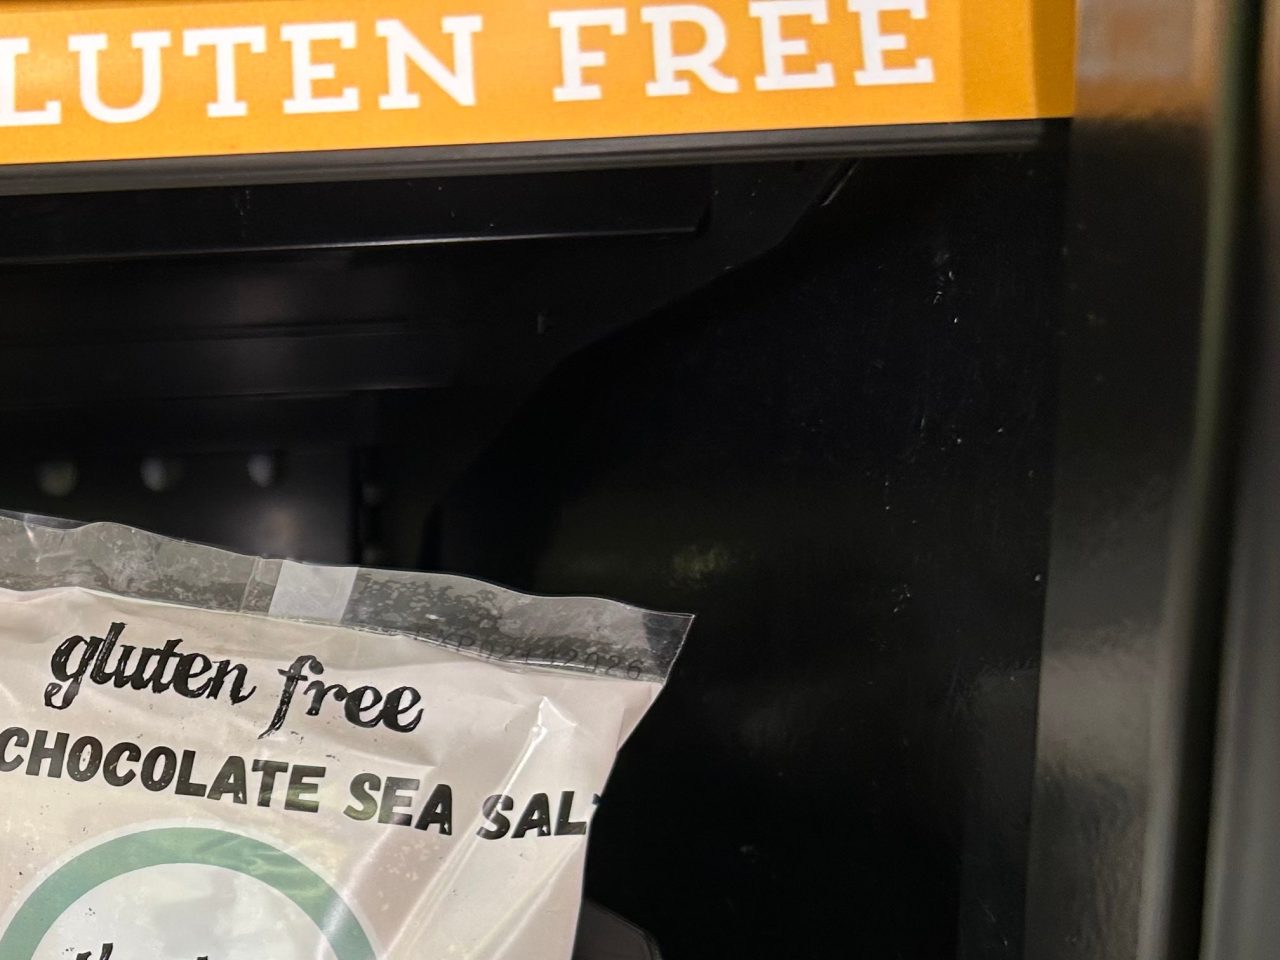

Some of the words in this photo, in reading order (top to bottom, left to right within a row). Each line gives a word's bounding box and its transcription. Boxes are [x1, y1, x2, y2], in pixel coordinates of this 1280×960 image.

[551, 0, 935, 103] FREE
[44, 622, 257, 711] gluten
[257, 654, 426, 740] free
[343, 772, 455, 836] SEA
[476, 790, 601, 840] SAL
